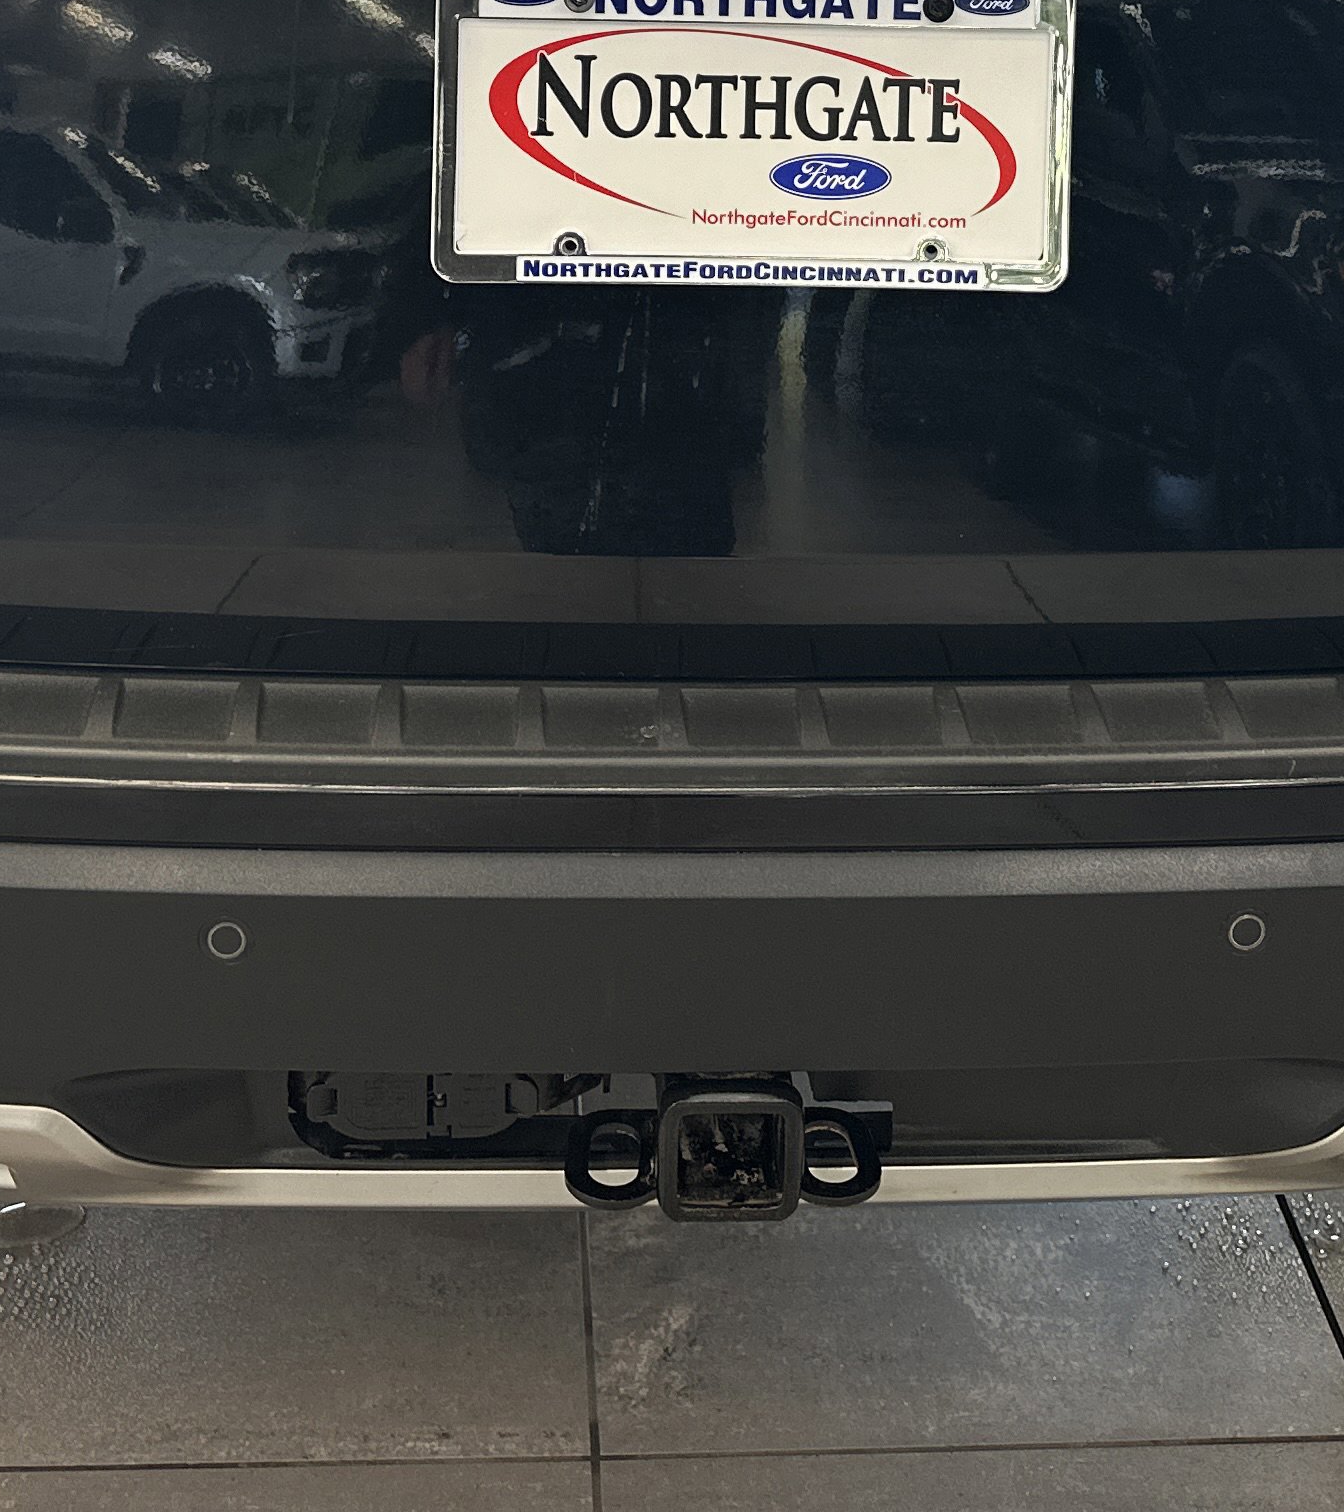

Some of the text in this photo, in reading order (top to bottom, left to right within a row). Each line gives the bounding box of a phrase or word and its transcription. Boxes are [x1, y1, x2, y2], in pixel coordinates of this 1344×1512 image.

[529, 52, 961, 143] NORTHGATE
[793, 159, 866, 191] Ford
[691, 208, 967, 230] NorthgateFordCincinnati.com
